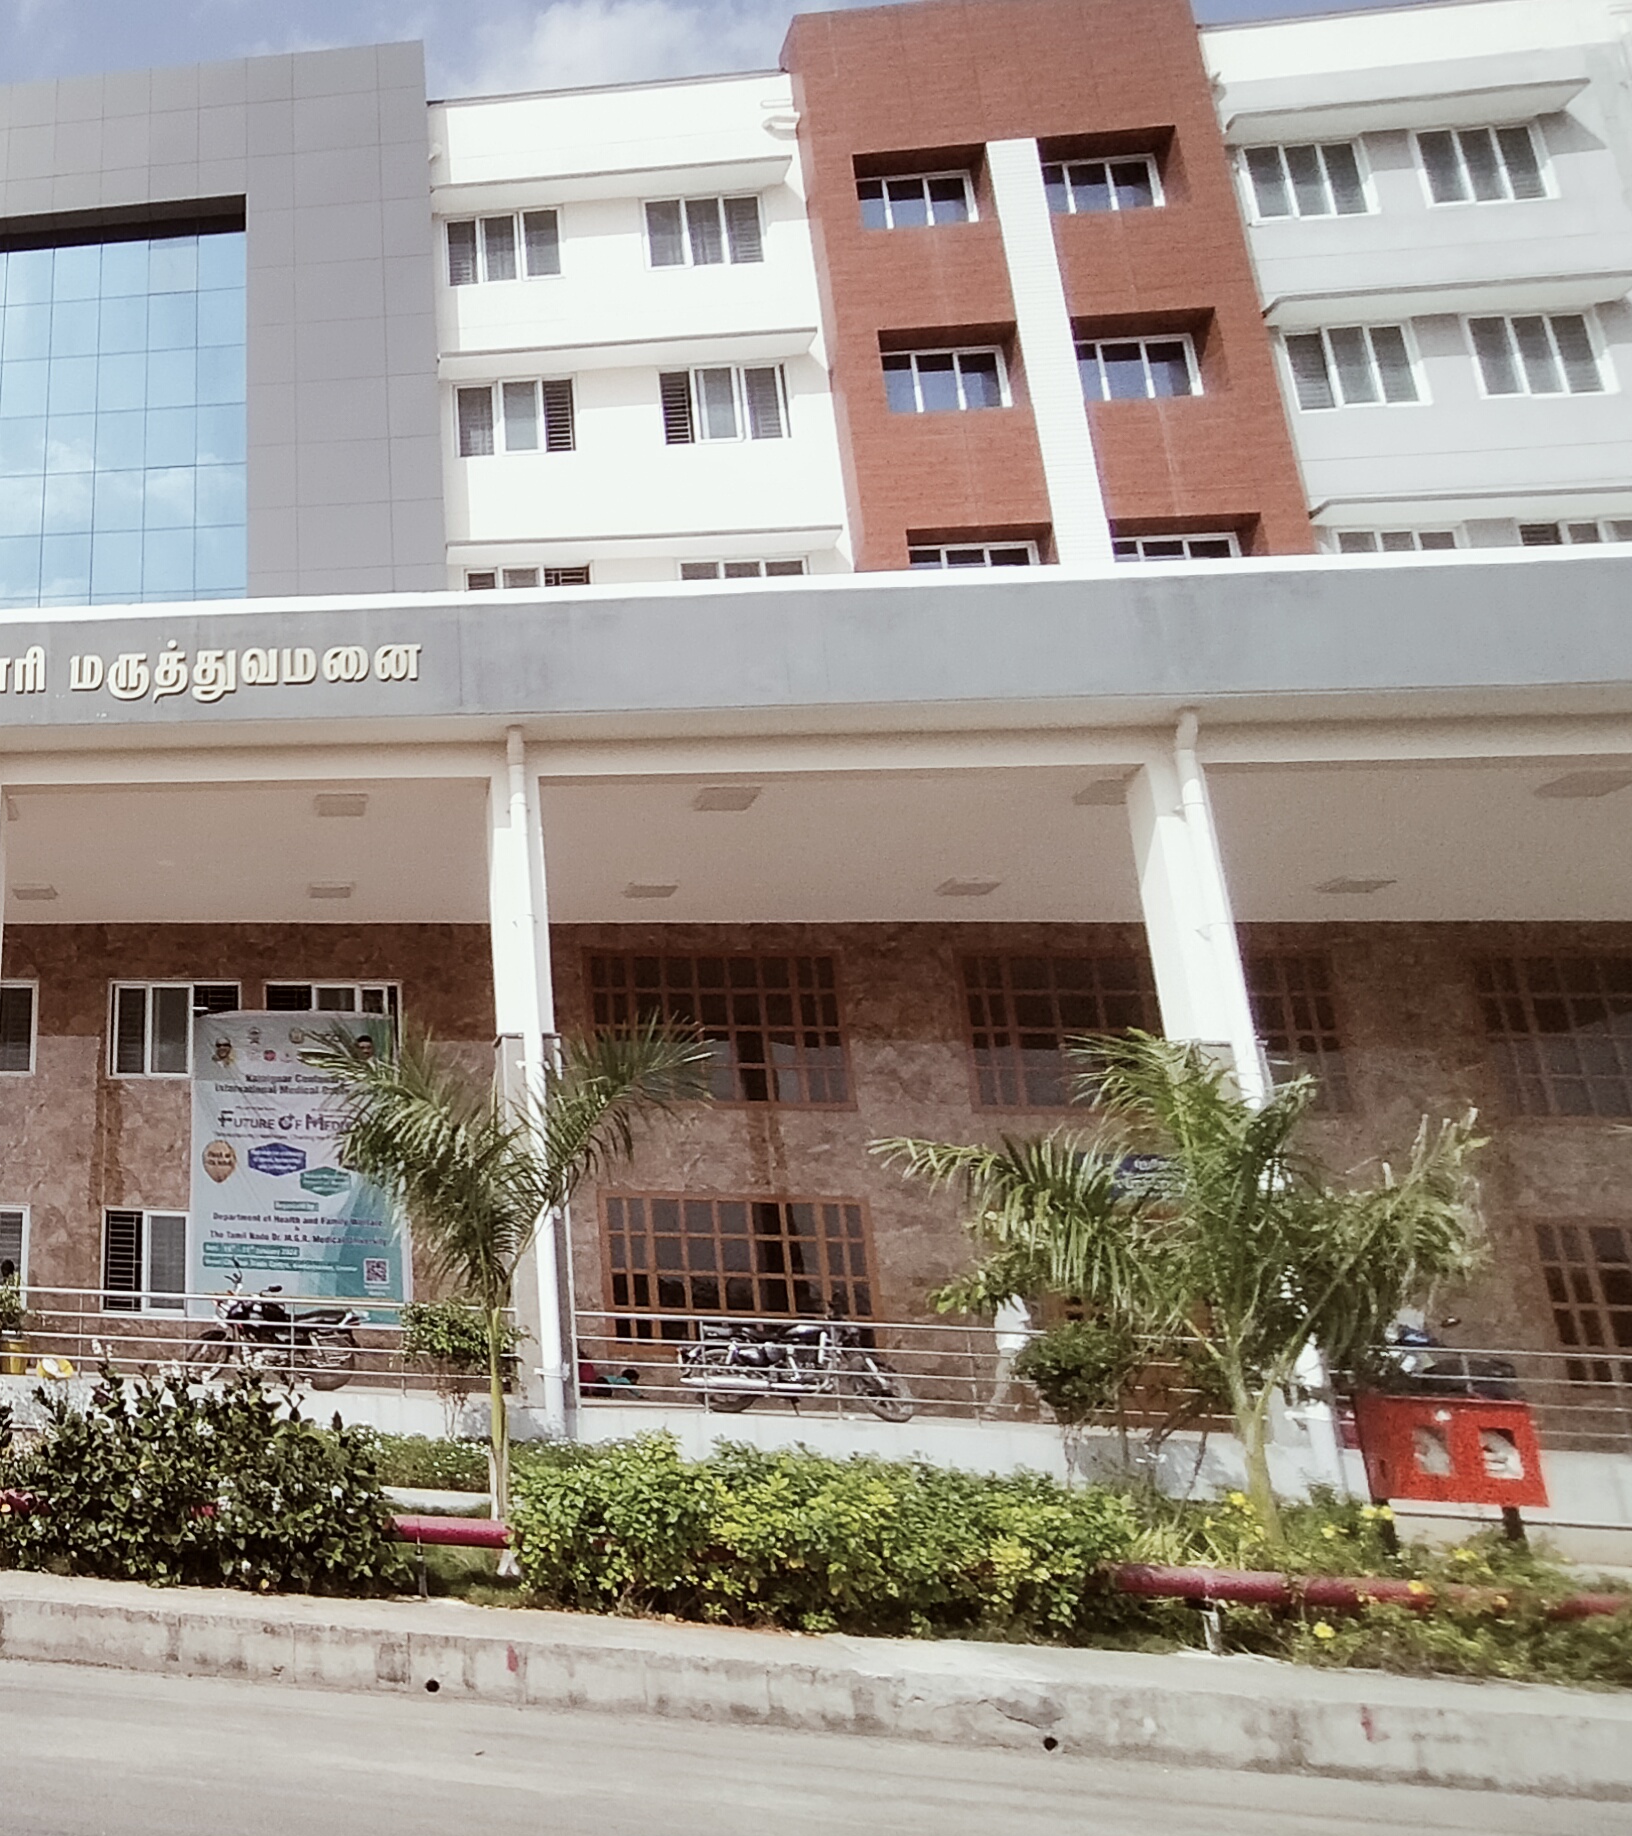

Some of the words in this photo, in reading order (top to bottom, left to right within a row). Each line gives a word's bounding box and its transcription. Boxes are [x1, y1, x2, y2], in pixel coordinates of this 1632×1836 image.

[69, 640, 424, 703] மருத்துவமனை
[213, 1212, 261, 1222] Department
[320, 1217, 348, 1226] Family
[210, 1230, 224, 1239] The
[226, 1231, 247, 1239] Tamil
[249, 1232, 269, 1240] Nadu
[312, 1235, 341, 1244] Medical
